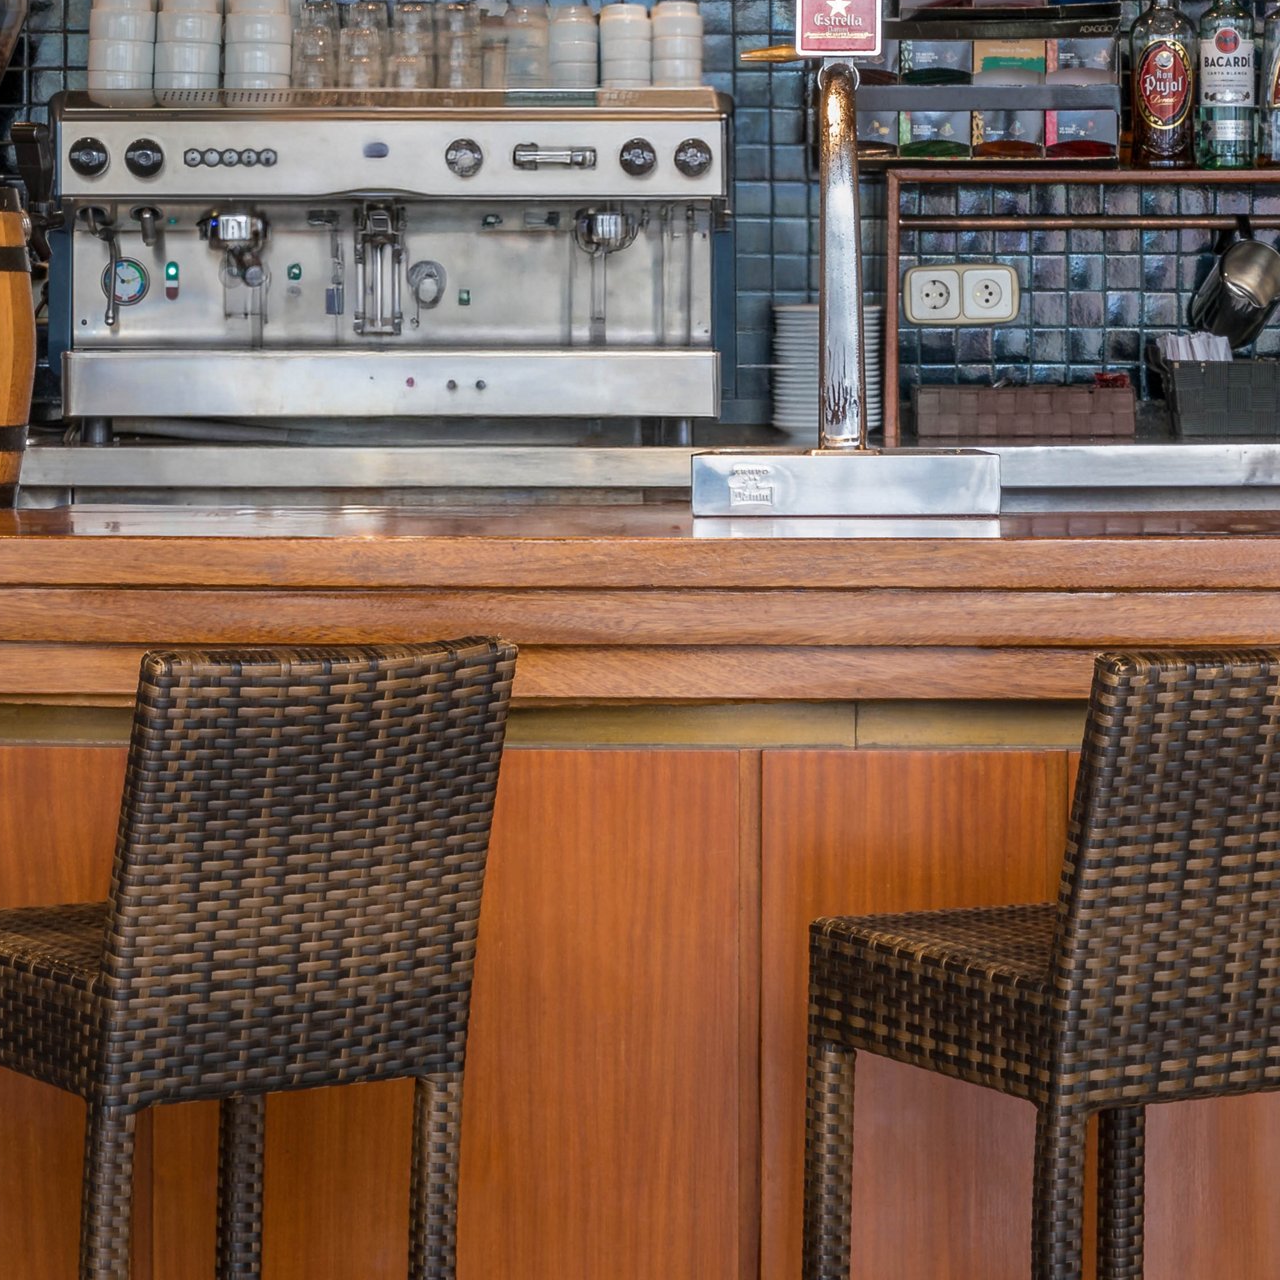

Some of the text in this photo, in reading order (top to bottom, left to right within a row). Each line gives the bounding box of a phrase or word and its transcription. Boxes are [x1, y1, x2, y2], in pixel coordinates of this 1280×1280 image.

[813, 13, 862, 26] Estrella
[1204, 53, 1251, 67] BACARDÍ
[1156, 70, 1173, 78] Ron
[1144, 74, 1183, 95] Pujol
